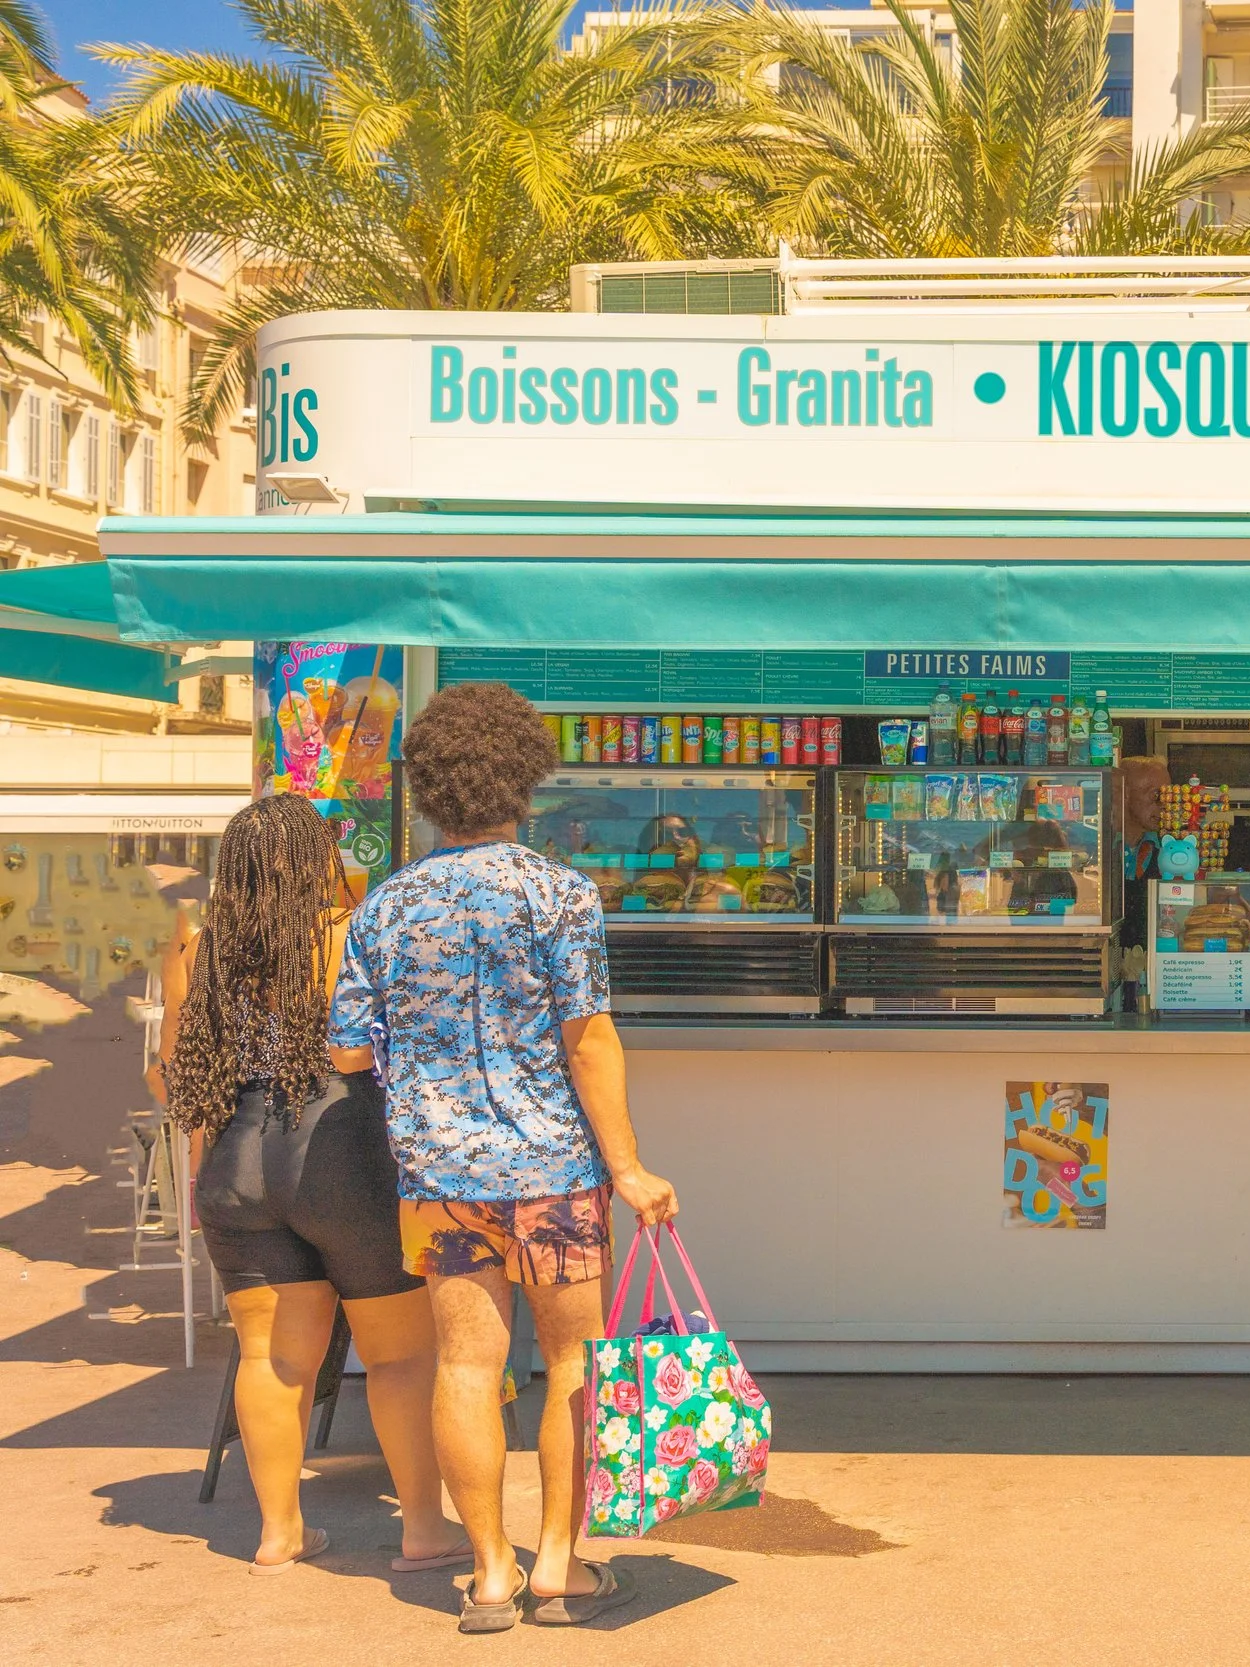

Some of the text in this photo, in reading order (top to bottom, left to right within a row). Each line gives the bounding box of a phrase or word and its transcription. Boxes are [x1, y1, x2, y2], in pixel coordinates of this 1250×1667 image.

[430, 345, 678, 425] Boissons
[737, 346, 934, 427] Granita
[887, 654, 1047, 677] PETITES FAIMS
